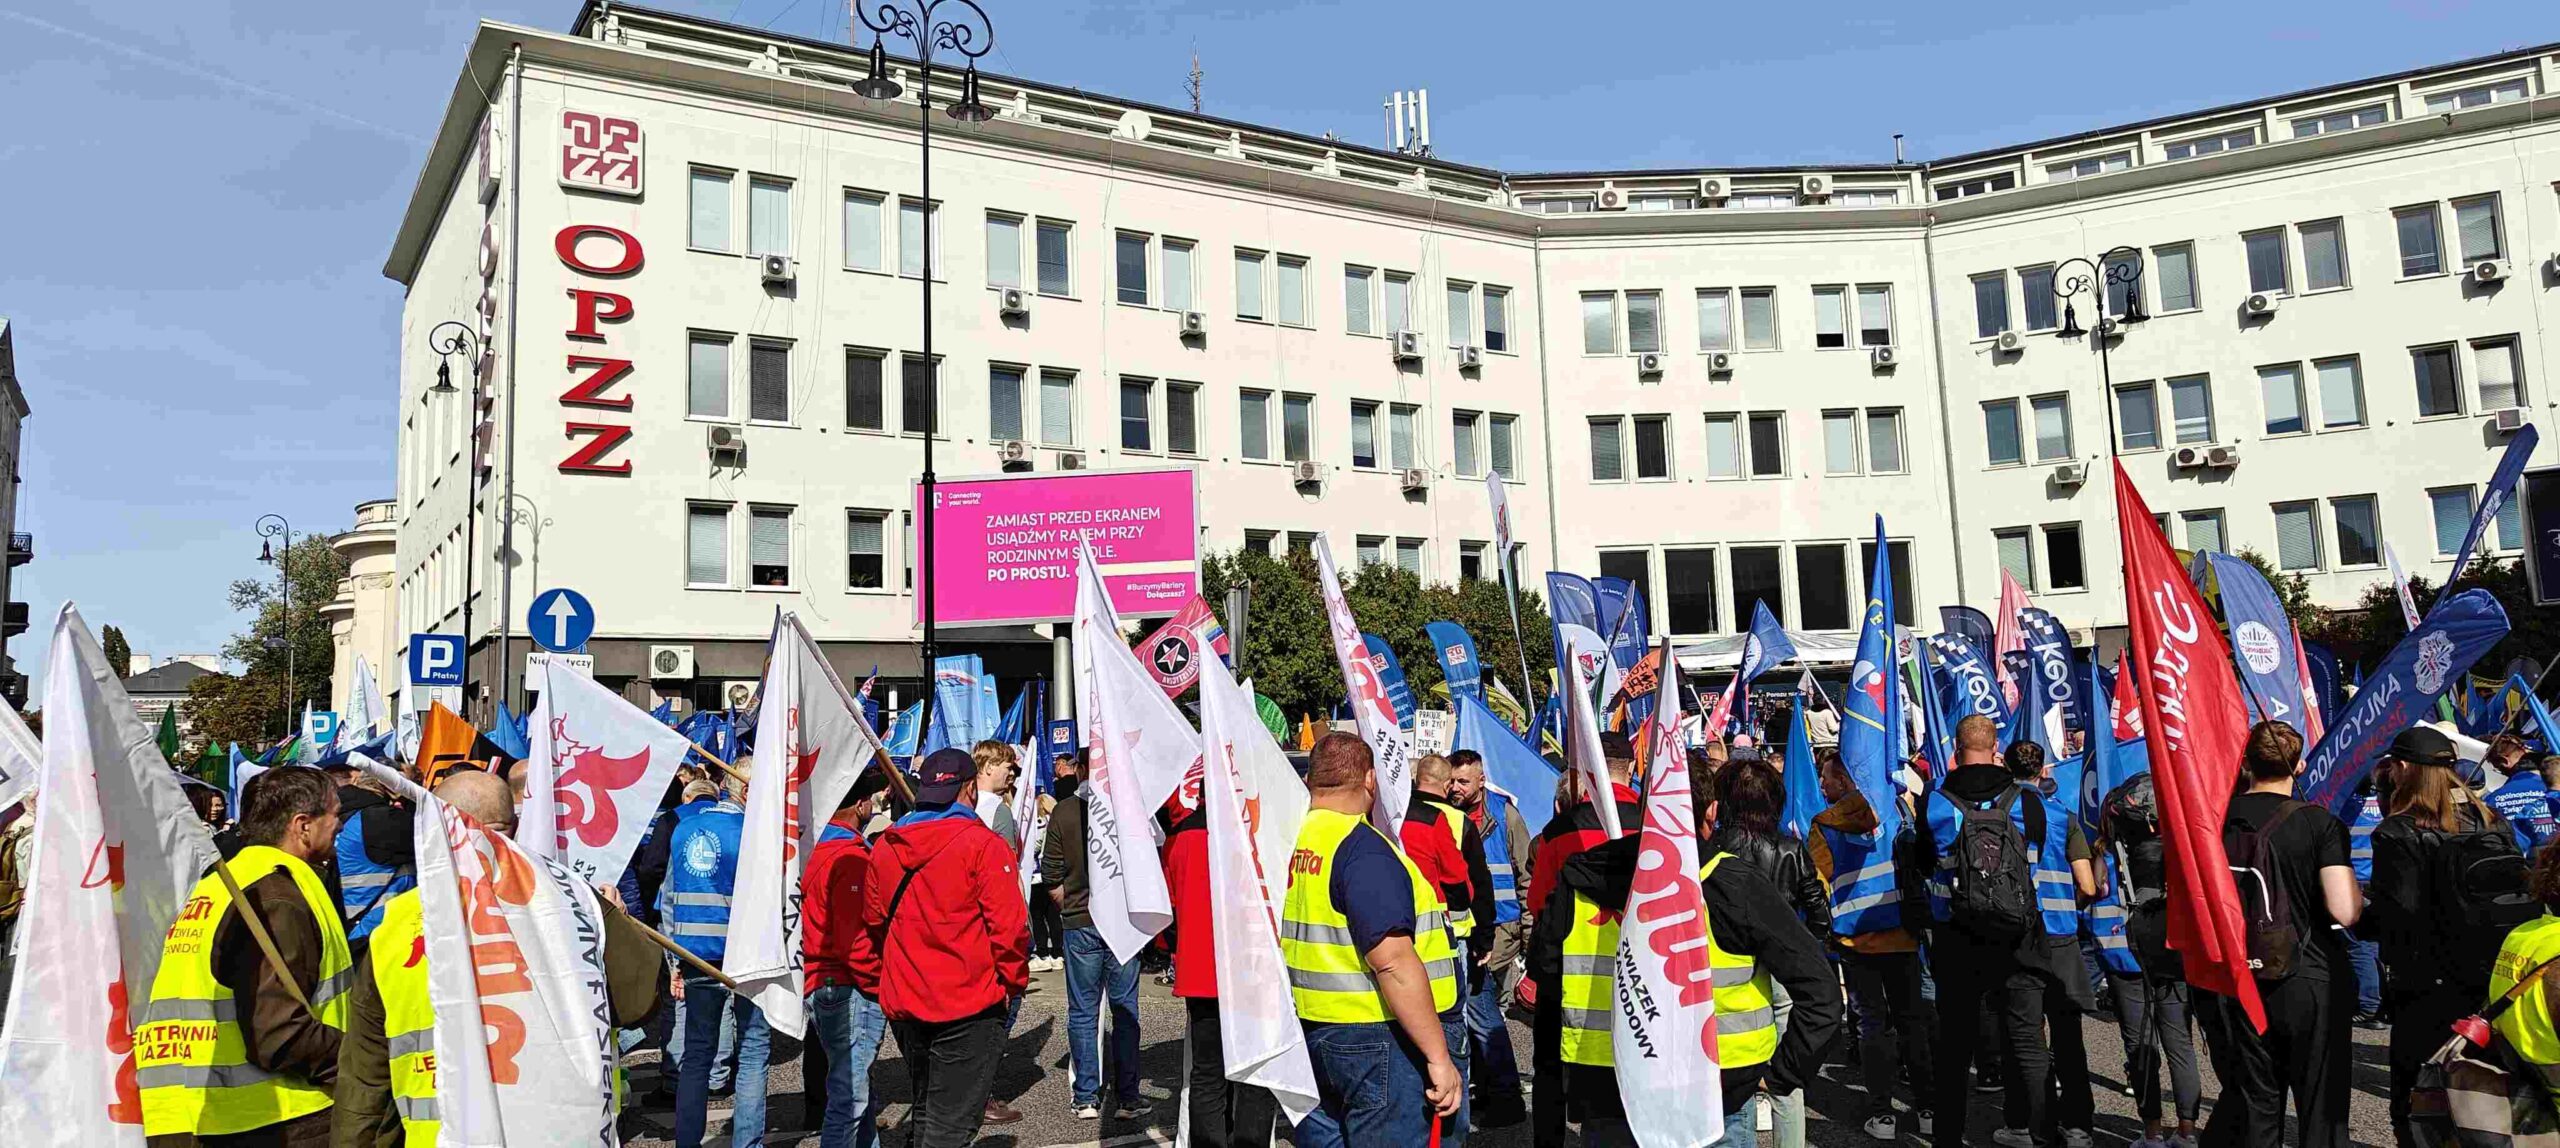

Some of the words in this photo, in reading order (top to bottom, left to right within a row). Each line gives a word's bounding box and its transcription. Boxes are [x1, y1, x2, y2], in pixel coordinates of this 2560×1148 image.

[554, 223, 645, 478] OPZZ
[948, 492, 982, 500] Connecting
[986, 512, 1046, 529] ZAMIAST
[1049, 510, 1092, 525] PRZED
[1095, 506, 1161, 523] EKRANEM
[986, 529, 1056, 547] USIĄDŹMY
[1110, 525, 1144, 540] PRZY
[987, 547, 1068, 564] RODZINNYM
[987, 567, 1008, 582] PO
[1010, 564, 1071, 581] PROSTU.
[1146, 590, 1186, 599] Dołączasz?
[421, 640, 454, 678] P
[433, 671, 459, 681] Płatny
[2305, 672, 2402, 793] POLICYJNA
[1620, 938, 1661, 1023] ZWIĄZEK
